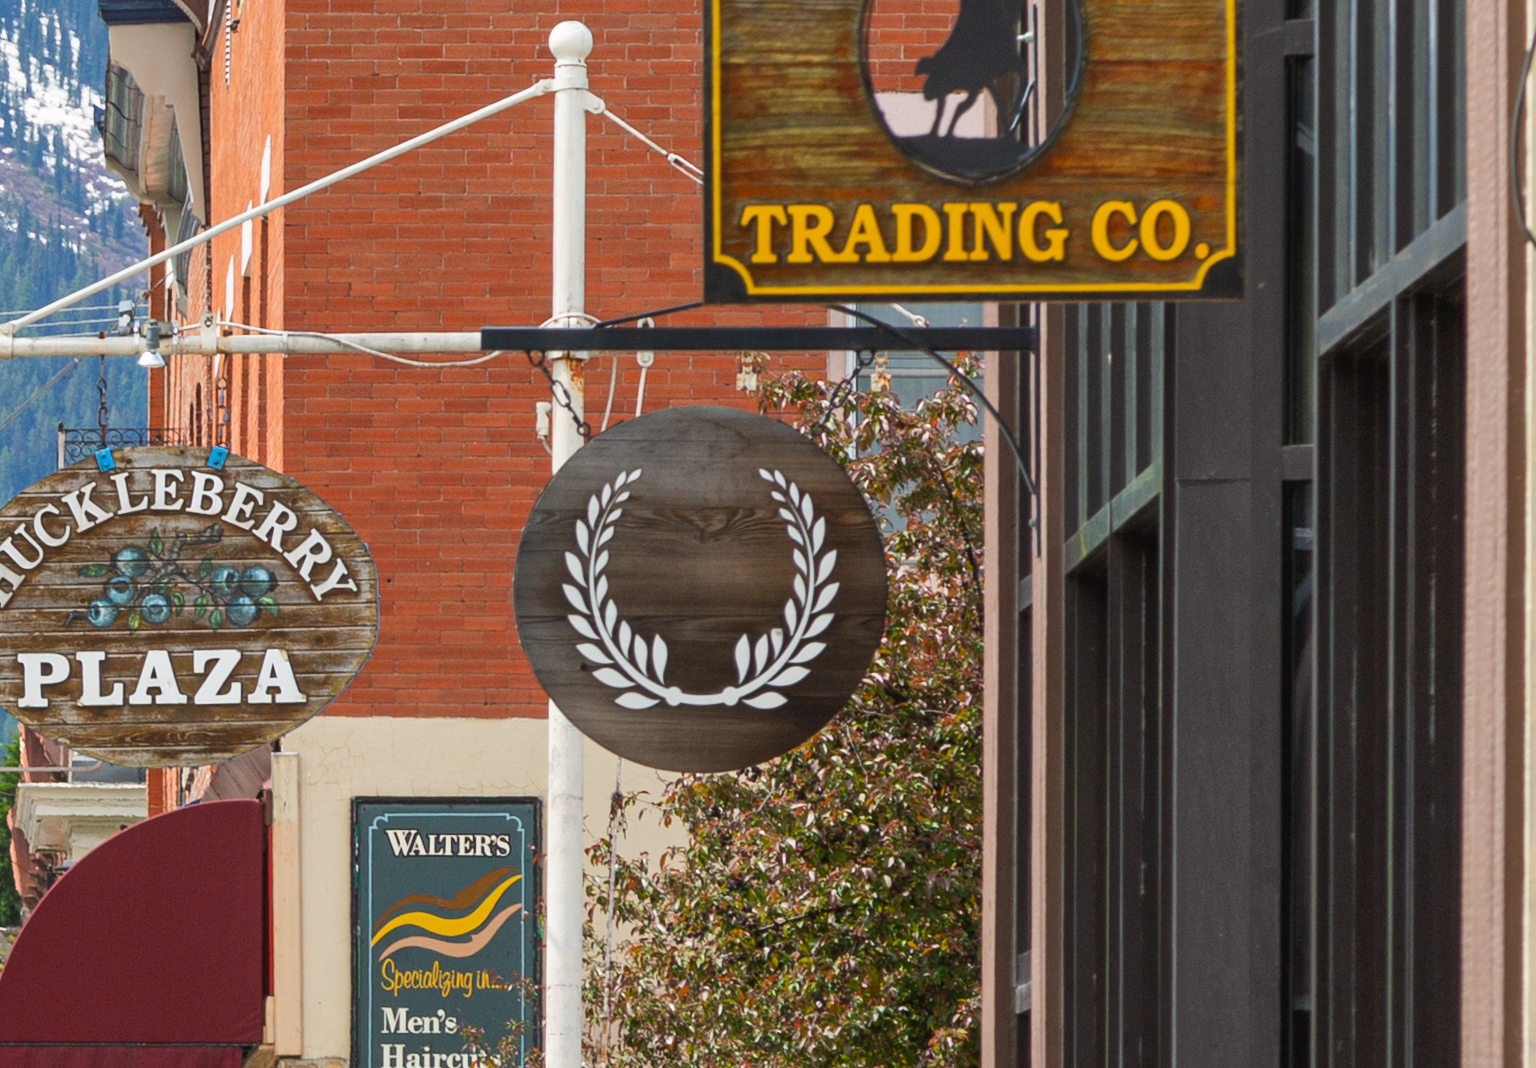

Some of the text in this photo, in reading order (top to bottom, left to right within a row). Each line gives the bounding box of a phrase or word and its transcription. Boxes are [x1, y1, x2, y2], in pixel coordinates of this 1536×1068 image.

[739, 199, 1210, 264] TRADING CO.
[16, 648, 307, 708] PLAZA
[385, 829, 511, 857] WALTER'S
[381, 957, 474, 998] Specializing
[380, 1006, 458, 1035] Men's
